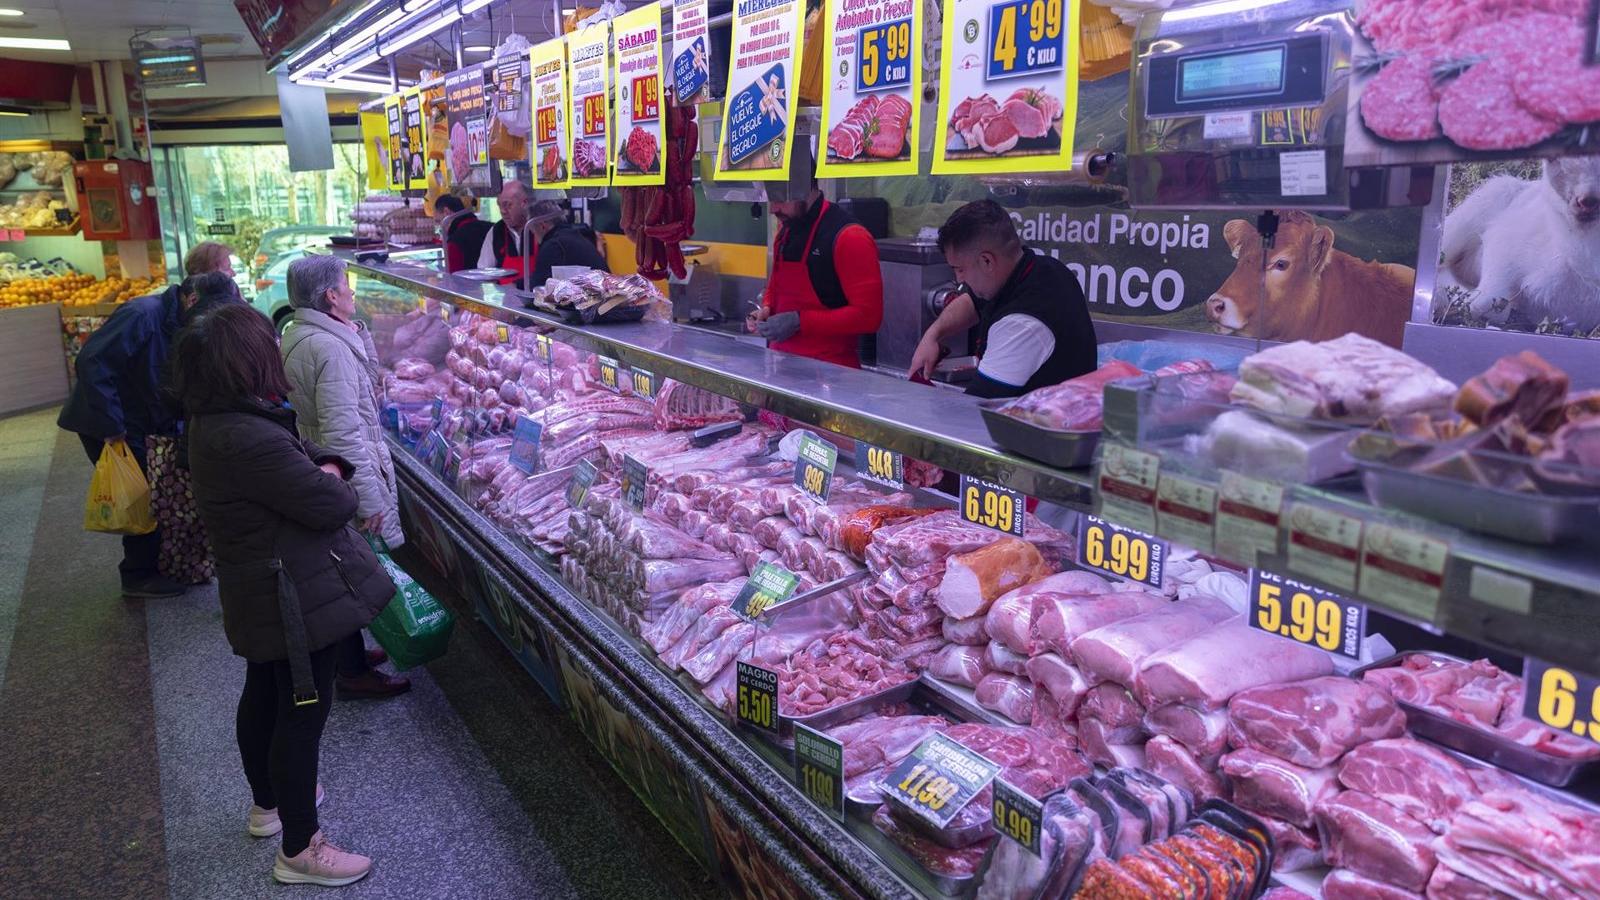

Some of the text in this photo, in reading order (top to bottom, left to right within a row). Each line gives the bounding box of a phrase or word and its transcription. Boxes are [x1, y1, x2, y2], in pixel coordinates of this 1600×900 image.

[618, 29, 657, 51] SÁBADO
[993, 0, 1061, 71] 4'99
[862, 22, 909, 86] 5'99
[1027, 46, 1056, 66] € KILO
[886, 65, 906, 81] € KILO
[634, 77, 658, 117] 4'99
[731, 102, 753, 126] VUELVE
[732, 113, 762, 143] EL CHEQUE
[731, 133, 757, 158] REGALO
[1009, 211, 1210, 254] Calidad Propia
[966, 486, 1013, 532] 6.99
[1014, 513, 1022, 534] EUROS
[1087, 526, 1148, 581] 6.99
[1150, 543, 1161, 585] EUROS KILO
[1258, 582, 1342, 651] 5.99
[1344, 606, 1360, 656] EUROS KILO
[738, 663, 777, 684] MAGRO
[740, 675, 775, 693] DE CERDO
[739, 685, 771, 728] 5.50
[797, 732, 840, 760] SOLOMILLO
[811, 748, 837, 769] CERDO
[940, 757, 981, 784] CERDO
[994, 800, 1033, 848] 9.99
